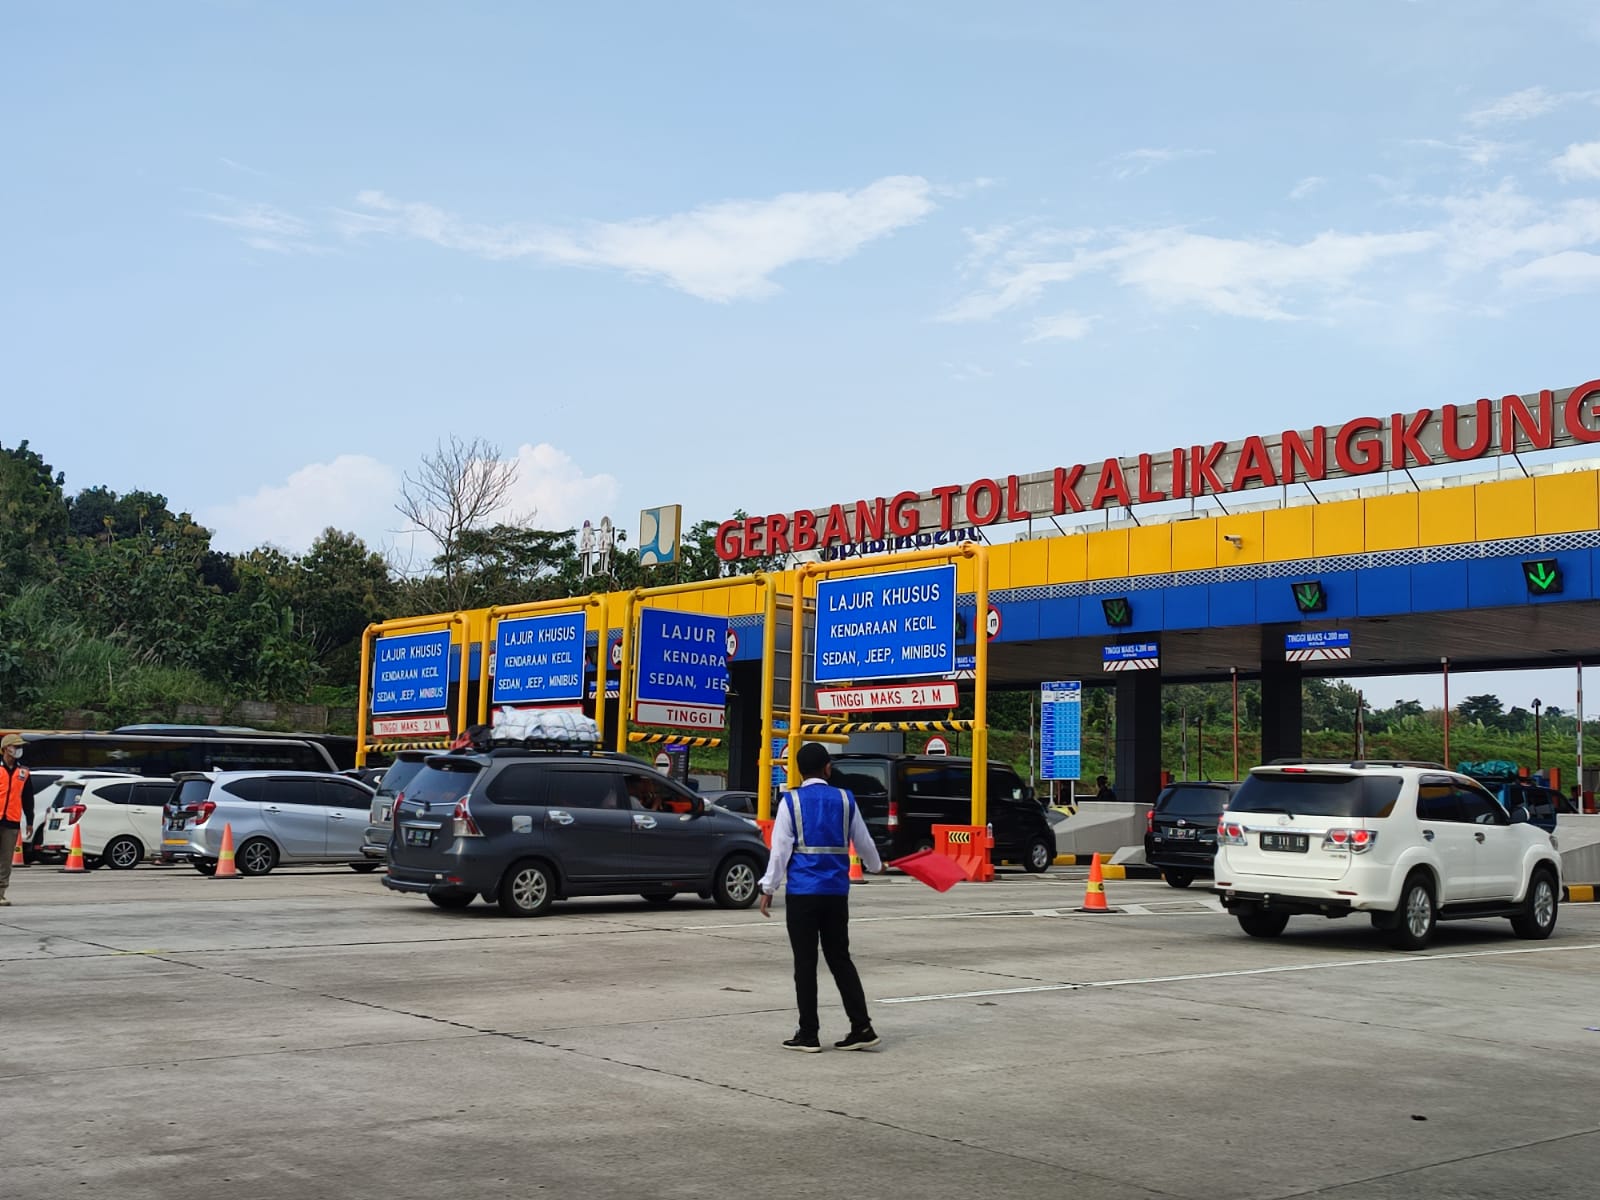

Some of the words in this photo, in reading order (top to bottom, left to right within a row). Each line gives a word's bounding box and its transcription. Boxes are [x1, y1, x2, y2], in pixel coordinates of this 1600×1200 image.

[715, 490, 921, 561] GERBANG
[931, 474, 1031, 532] TOL
[1052, 378, 1600, 515] KALIKANGKUNG
[829, 591, 874, 612] LAJUR
[882, 584, 940, 606] KHUSUS
[661, 624, 716, 643] LAJUR
[830, 619, 897, 638] KENDARAAN
[904, 616, 936, 632] KECIL
[505, 630, 533, 646] LAJUR
[538, 626, 576, 642] KHUSUS
[1288, 634, 1306, 642] TINGGI
[1307, 633, 1322, 641] MAKS
[382, 648, 406, 662] LAJUR
[410, 644, 442, 659] KHUSUS
[822, 646, 860, 668] SEDAN,
[864, 648, 894, 664] JEEP,
[901, 643, 947, 661] MINIBUS
[1105, 646, 1120, 654] TINGGI
[1122, 645, 1134, 653] MAKS
[505, 654, 548, 668] KENDARAAN
[552, 652, 572, 664] KECIL
[382, 669, 418, 681] KENDARAAN
[422, 667, 439, 677] KECIL
[498, 678, 522, 691] SEDAN,
[525, 676, 545, 689] JEEP,
[549, 674, 578, 686] MINIBUS
[649, 672, 697, 689] SEDAN,
[377, 690, 398, 703] SEDAN,
[400, 689, 416, 701] JEEP,
[419, 687, 443, 699] MINIBUS
[830, 692, 864, 708] TINGGI
[932, 689, 942, 702] M
[667, 709, 712, 723] TINGGI
[380, 723, 398, 732] TINGGI
